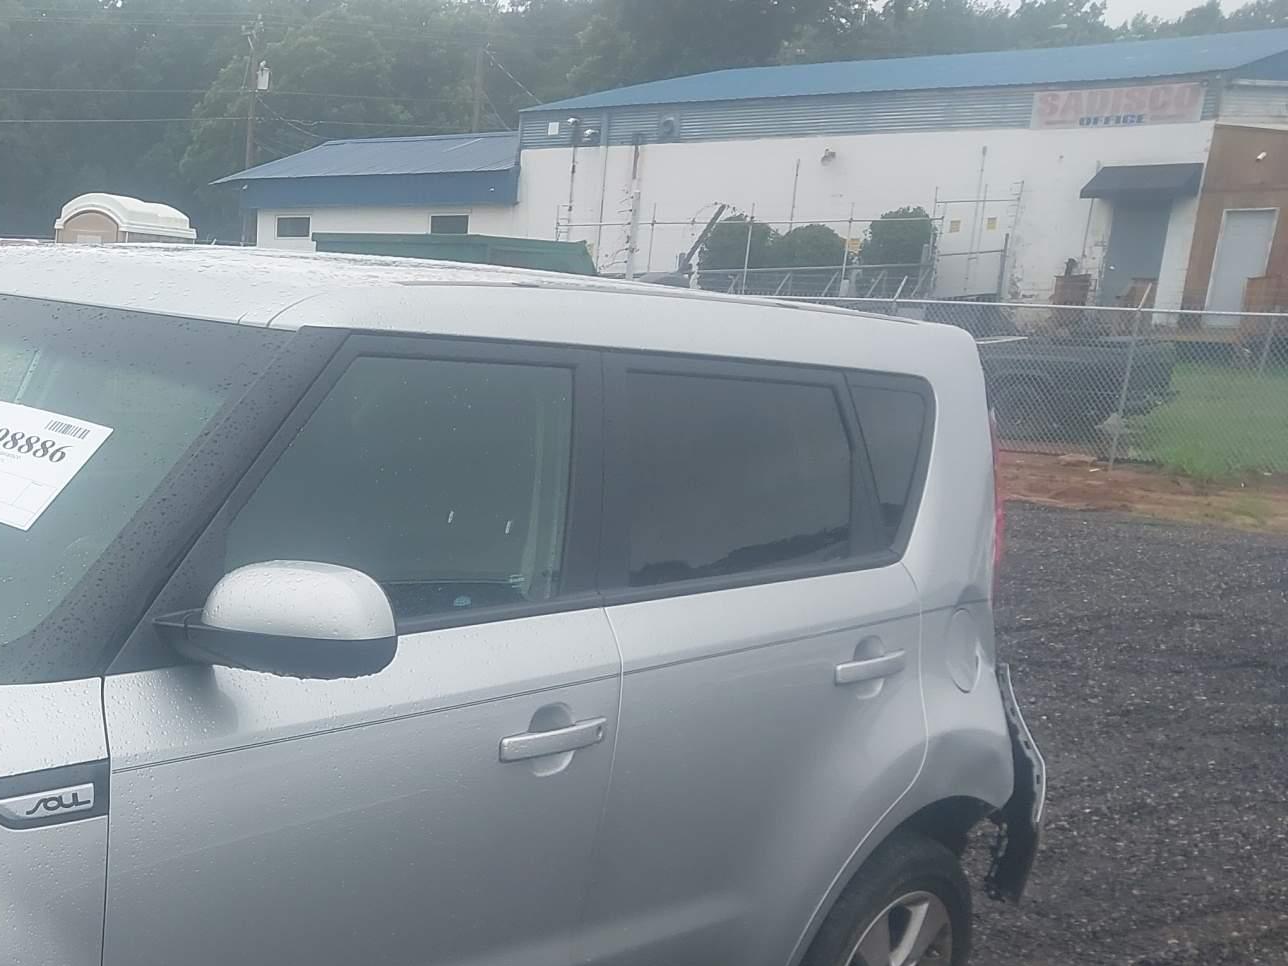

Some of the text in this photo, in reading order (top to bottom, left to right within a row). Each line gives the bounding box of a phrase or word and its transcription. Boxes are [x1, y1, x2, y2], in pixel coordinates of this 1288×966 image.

[1038, 84, 1201, 116] SADISCO
[1079, 113, 1145, 127] OFFICE
[26, 792, 91, 815] SOUL
